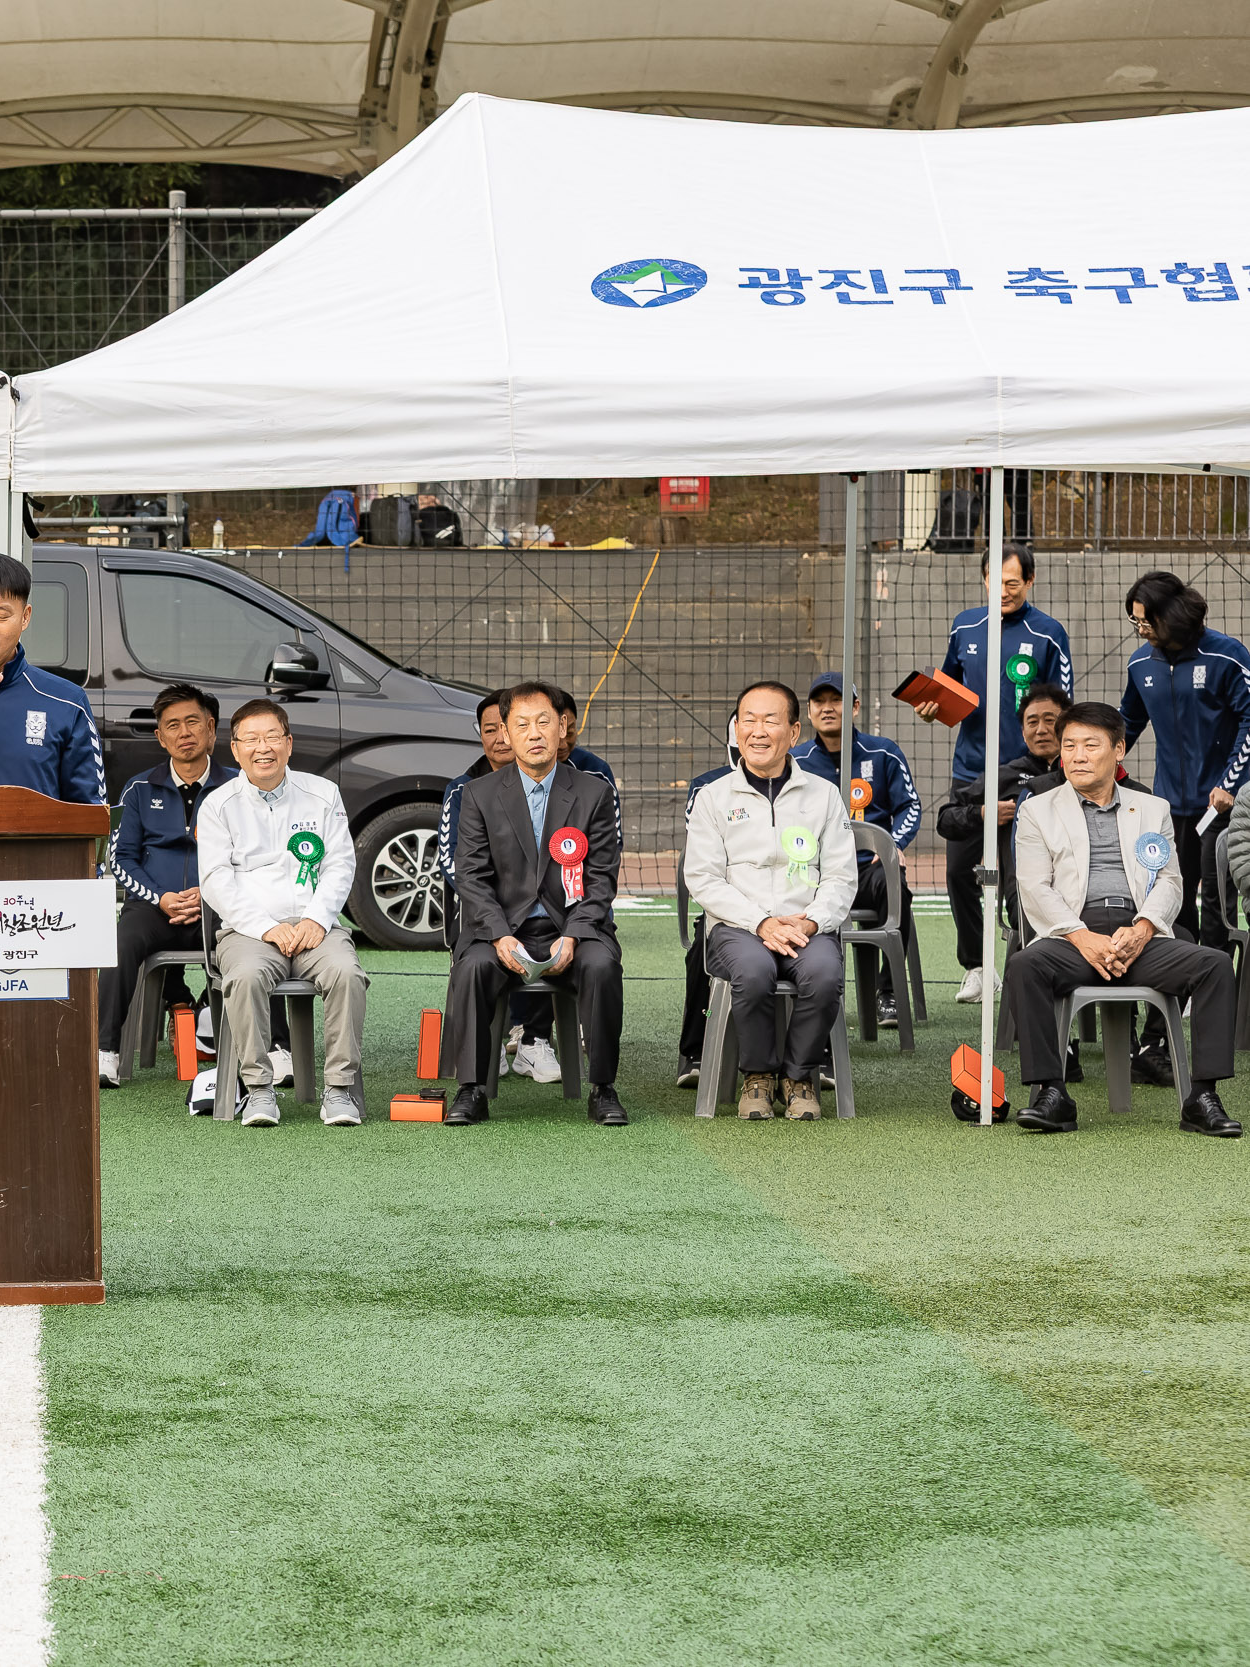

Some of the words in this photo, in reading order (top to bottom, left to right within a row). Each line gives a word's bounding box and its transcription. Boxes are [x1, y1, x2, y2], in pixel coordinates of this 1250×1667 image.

[738, 268, 974, 306] 광진구
[1003, 262, 1250, 305] 축구협
[3, 895, 35, 911] 30주년
[2, 950, 39, 961] 광진구
